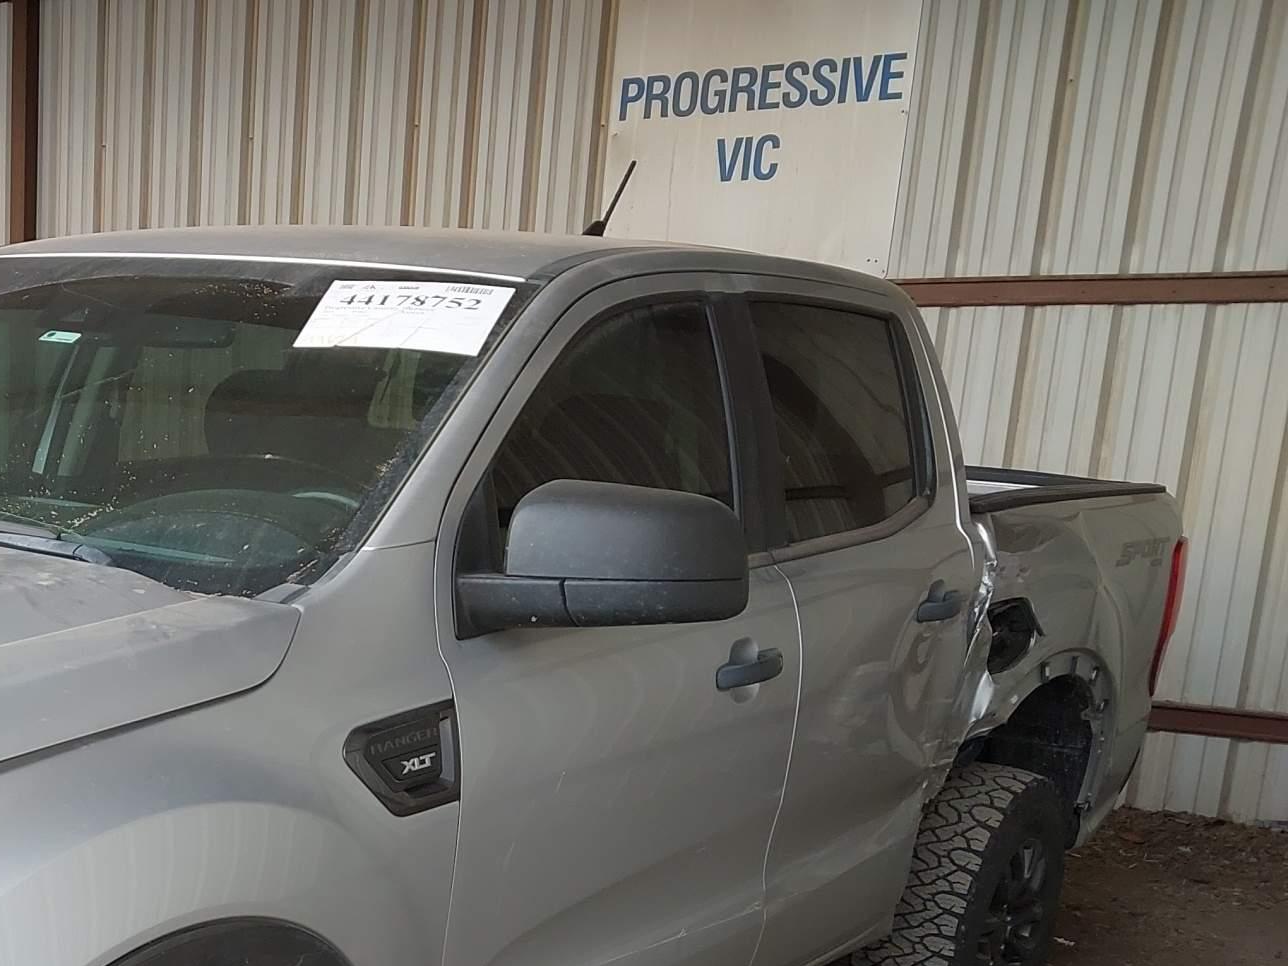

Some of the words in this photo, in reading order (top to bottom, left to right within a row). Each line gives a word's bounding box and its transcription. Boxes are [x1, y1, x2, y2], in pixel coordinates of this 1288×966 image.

[618, 52, 908, 122] PROGRESSIVE
[716, 133, 781, 182] VIC
[339, 294, 482, 311] 44178752
[369, 727, 440, 755] RANGER
[400, 751, 436, 775] XLT
